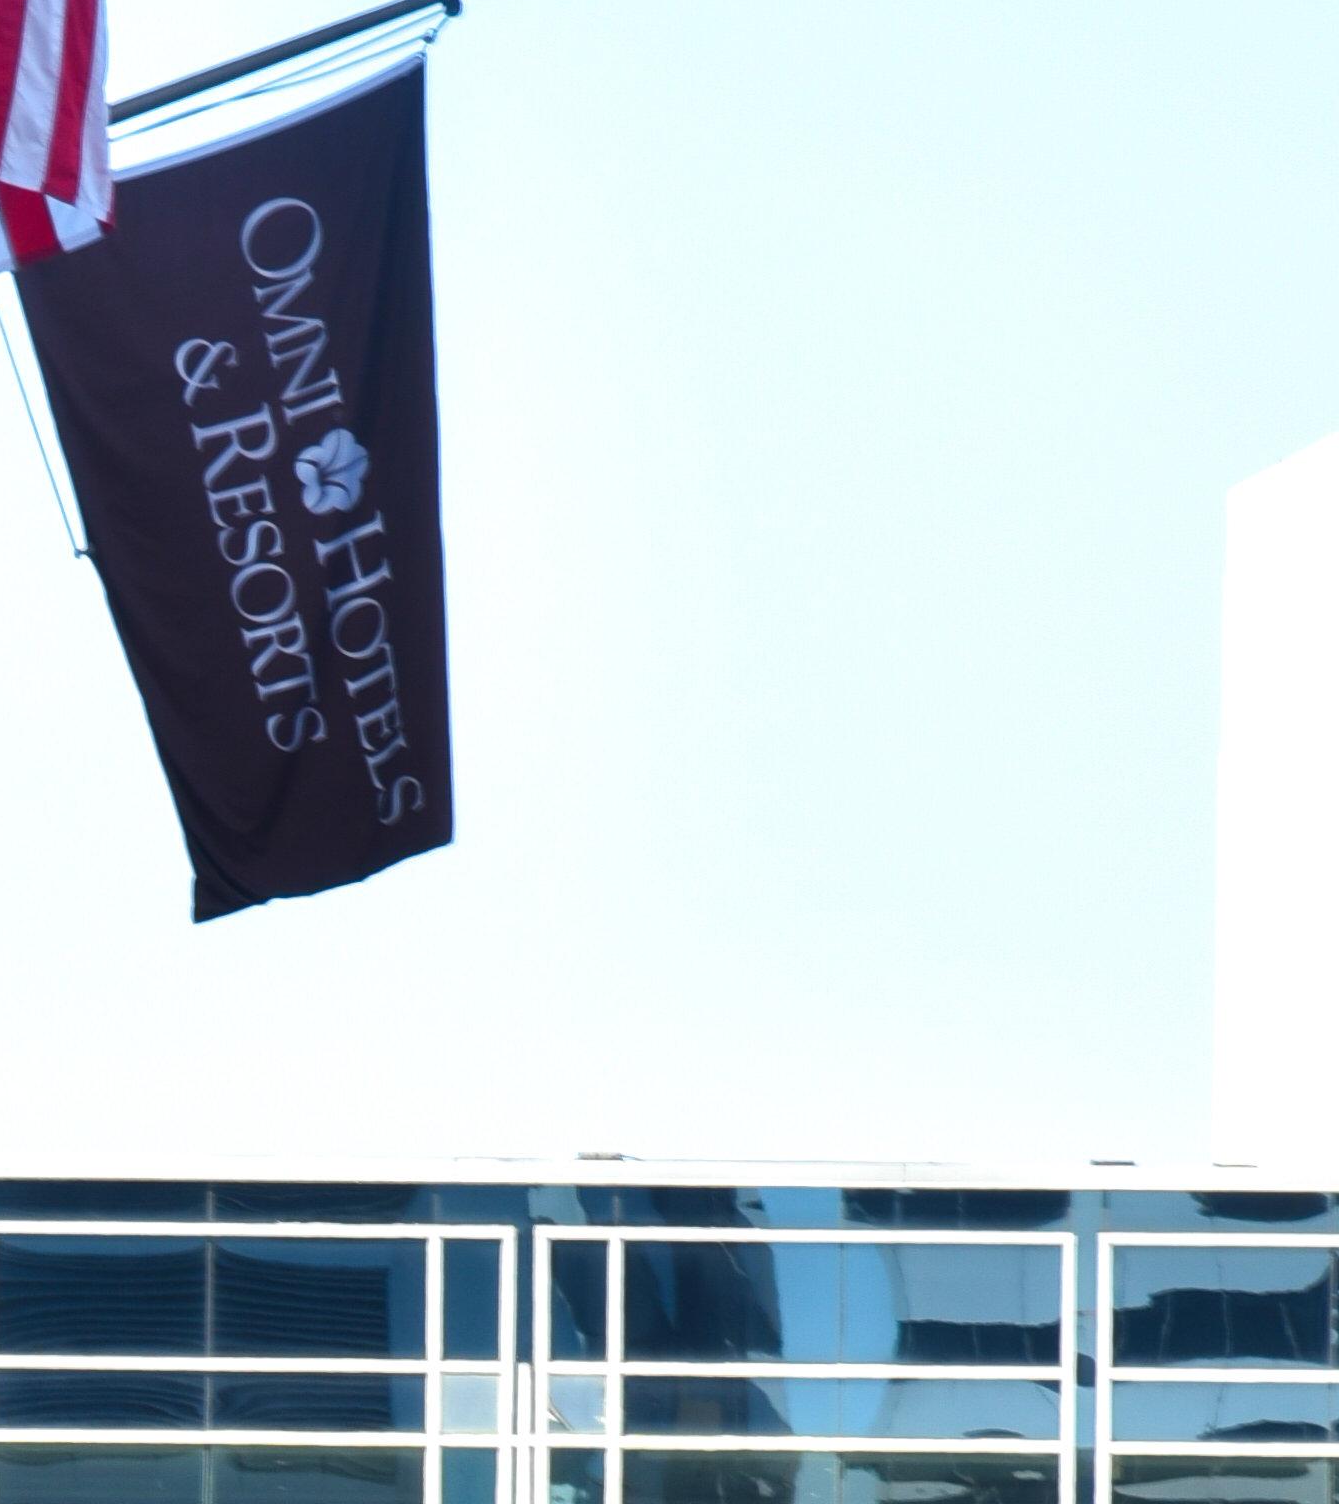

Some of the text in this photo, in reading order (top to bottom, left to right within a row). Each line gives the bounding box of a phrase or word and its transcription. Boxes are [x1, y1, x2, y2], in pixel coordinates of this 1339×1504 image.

[175, 337, 328, 752] & RESORTS
[240, 196, 424, 826] OMNI HOTELS
